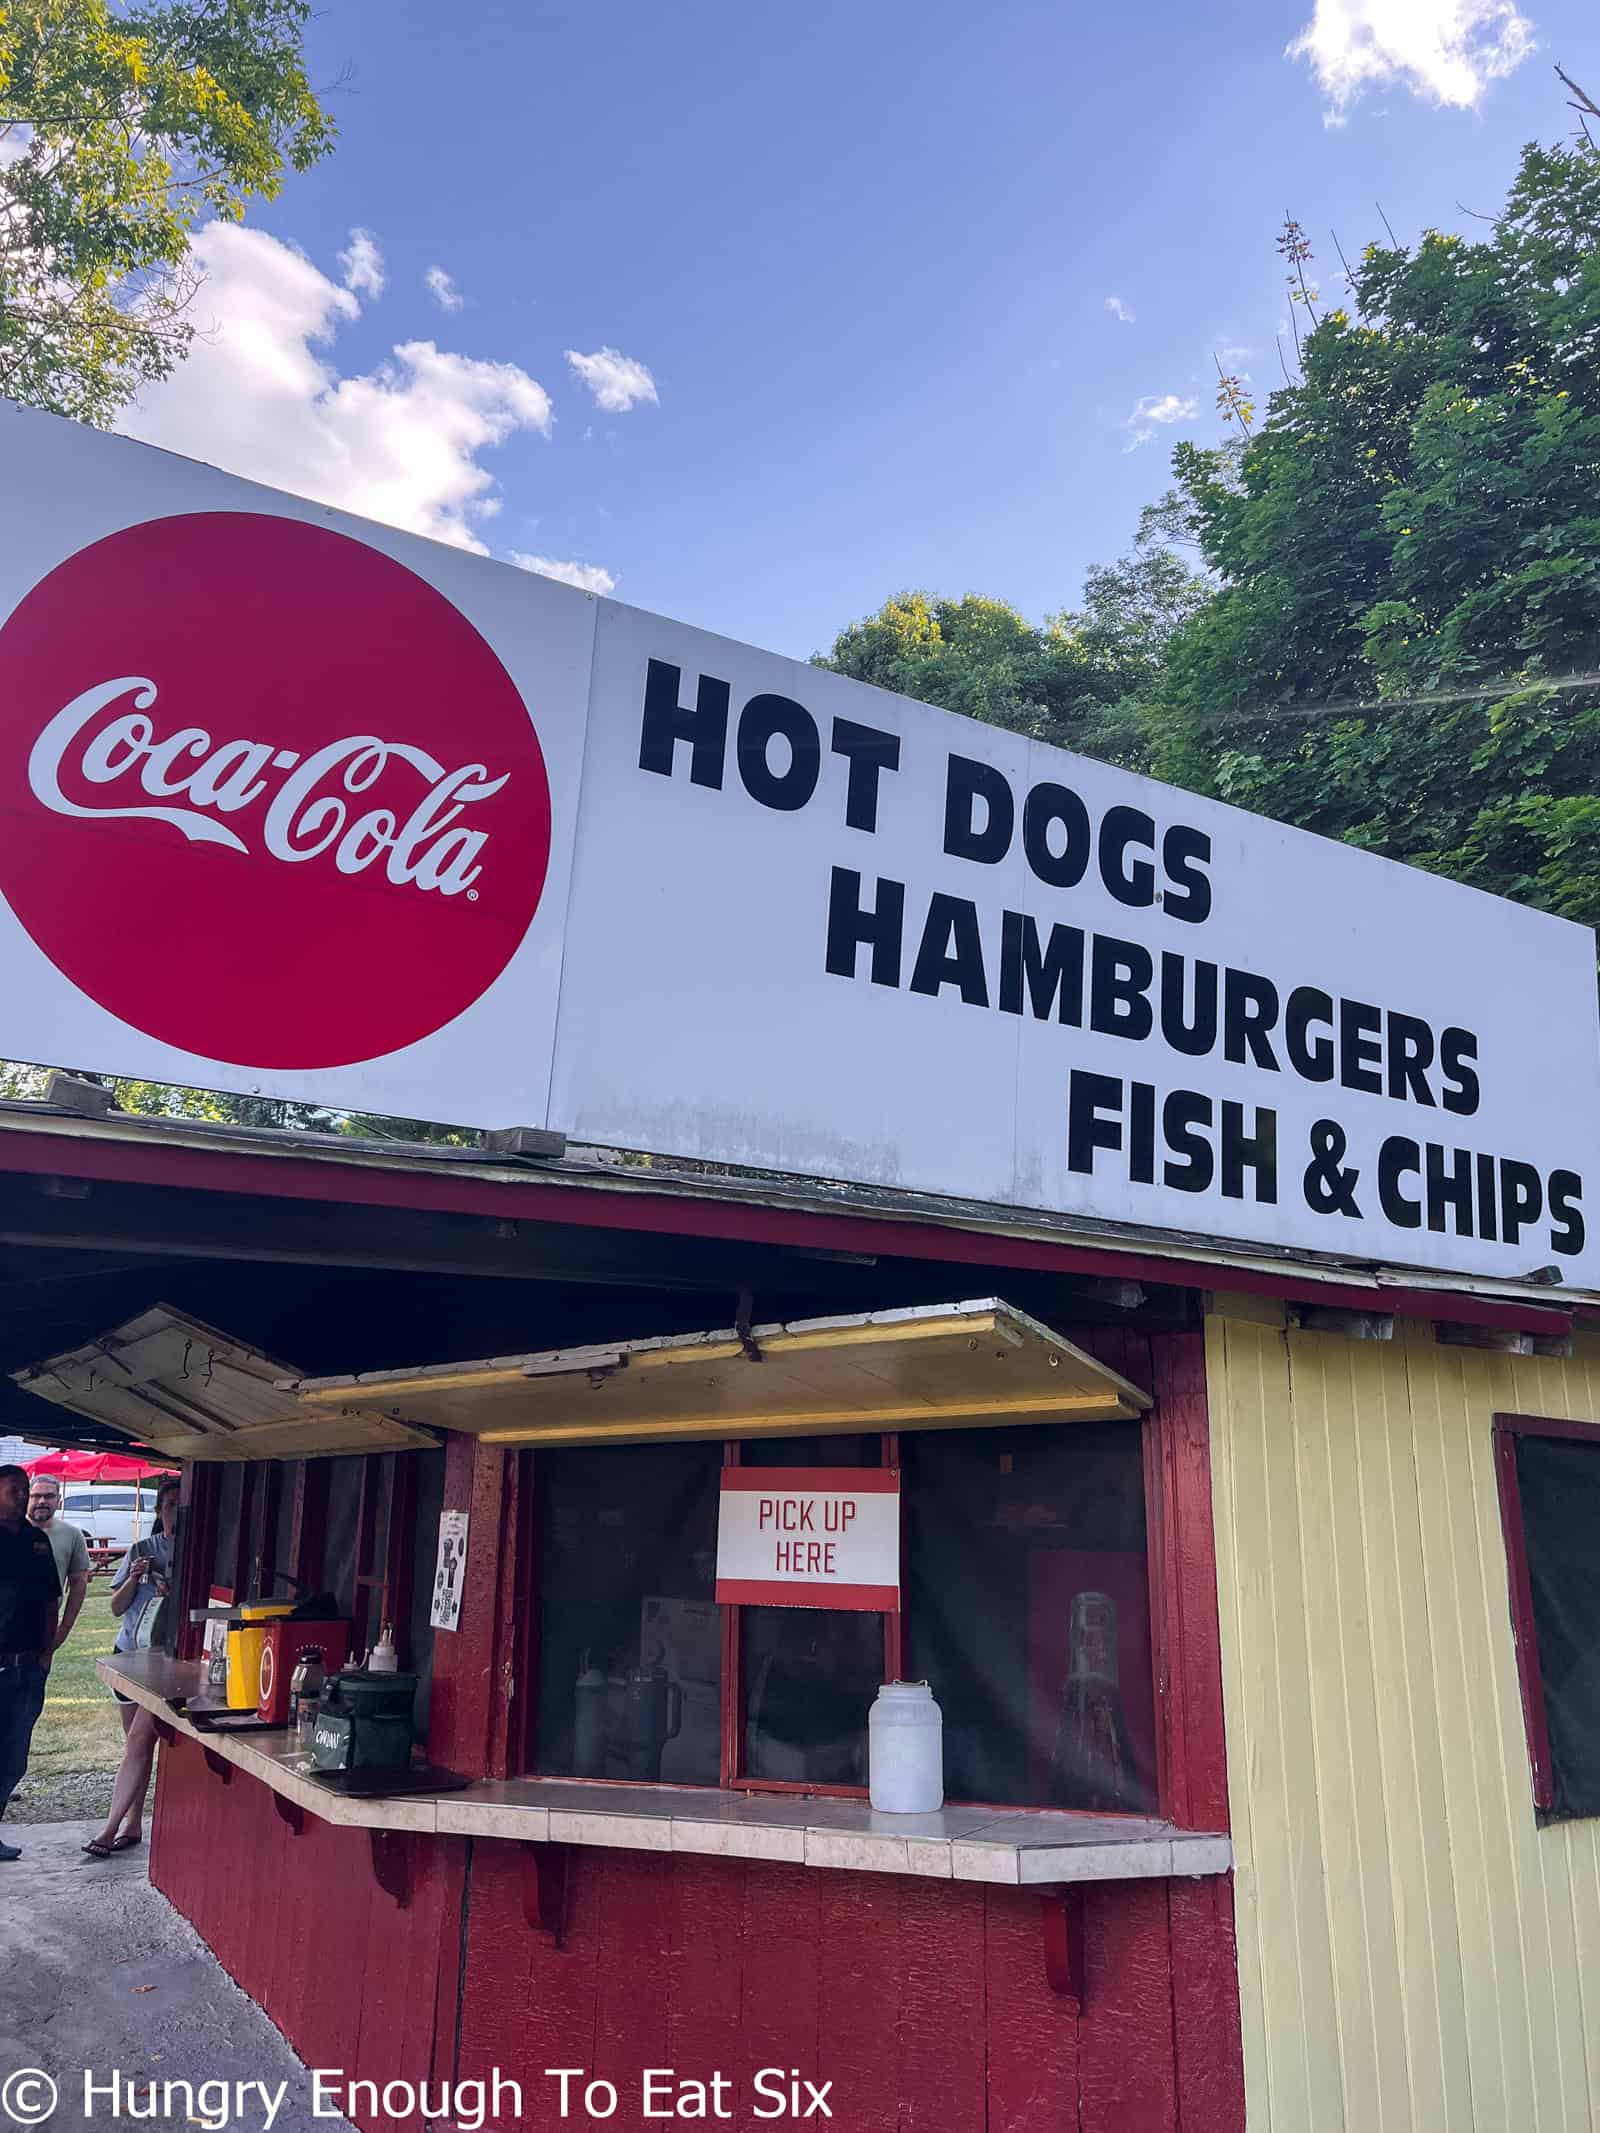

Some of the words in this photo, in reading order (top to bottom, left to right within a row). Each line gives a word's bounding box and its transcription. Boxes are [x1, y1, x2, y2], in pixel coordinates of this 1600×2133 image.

[28, 676, 511, 896] Coca-Cola
[638, 657, 901, 834] HOT
[943, 752, 1212, 924] DOGS
[825, 865, 1480, 1116] HAMBURGERS
[1067, 1068, 1278, 1205] FISH
[1303, 1118, 1364, 1220] &
[1377, 1135, 1585, 1256] CHIPS
[759, 1499, 815, 1531] PICK
[824, 1500, 856, 1532] UP
[776, 1541, 836, 1574] HERE
